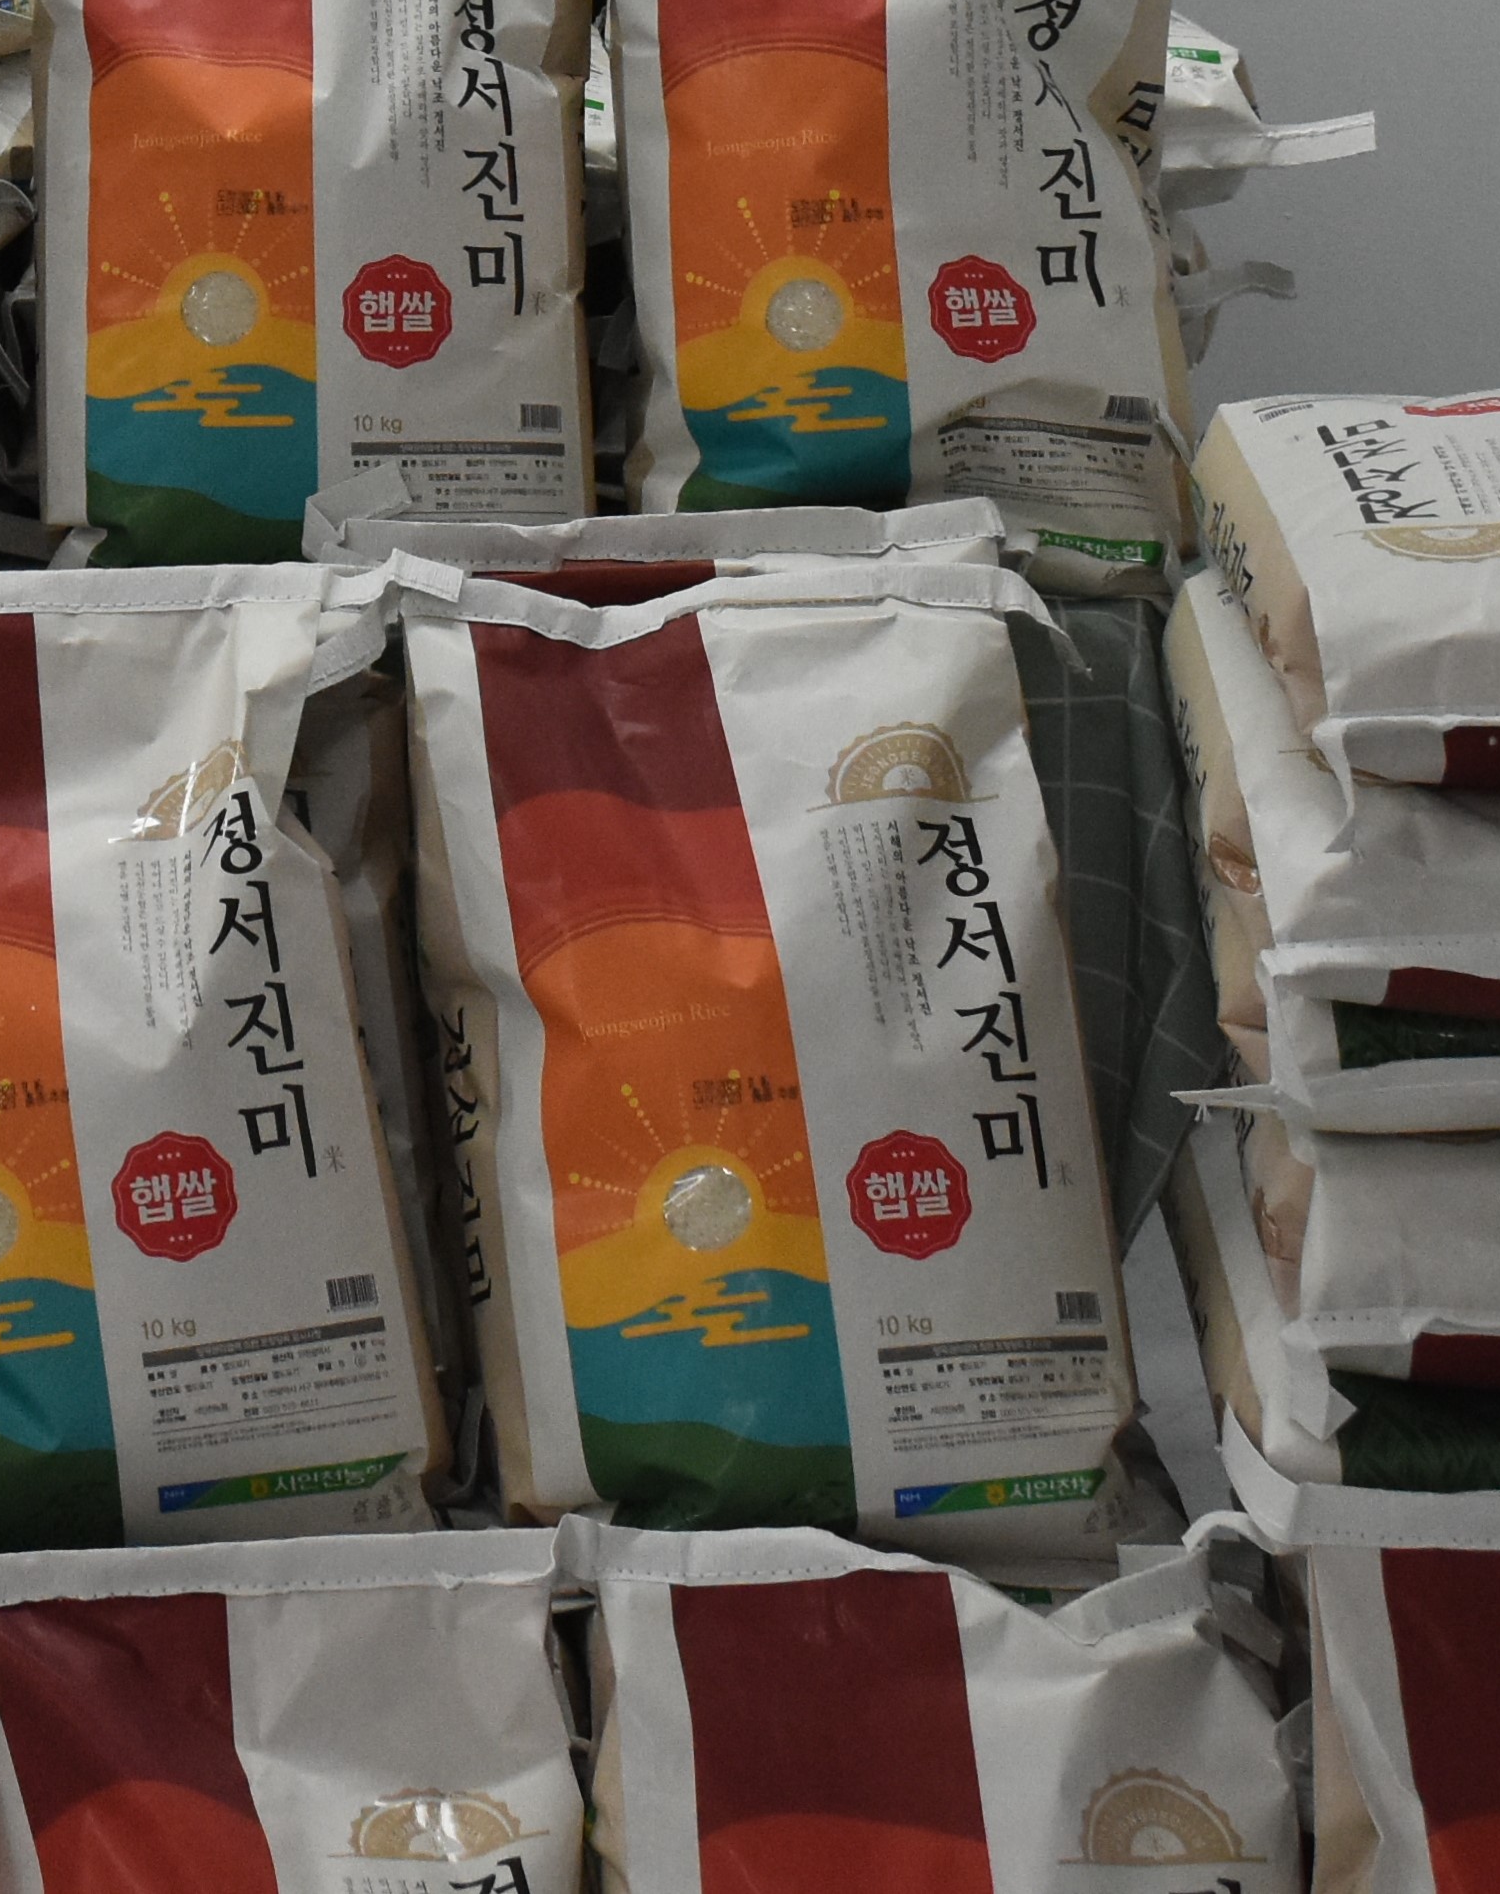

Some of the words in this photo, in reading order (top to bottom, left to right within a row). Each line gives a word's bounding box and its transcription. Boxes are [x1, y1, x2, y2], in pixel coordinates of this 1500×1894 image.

[358, 289, 437, 336] 햅쌀
[944, 285, 1018, 328] 햅쌀
[353, 414, 375, 434] 10
[379, 413, 404, 438] kg
[199, 790, 319, 1180] 정서진미
[916, 814, 1049, 1191] 정서진미
[689, 1002, 732, 1022] Rice
[128, 1169, 219, 1227] 햅쌀
[864, 1167, 952, 1222] 햅쌀
[141, 1319, 164, 1341] 10
[170, 1317, 197, 1338] kg
[876, 1315, 900, 1336] 10
[907, 1314, 933, 1336] kg
